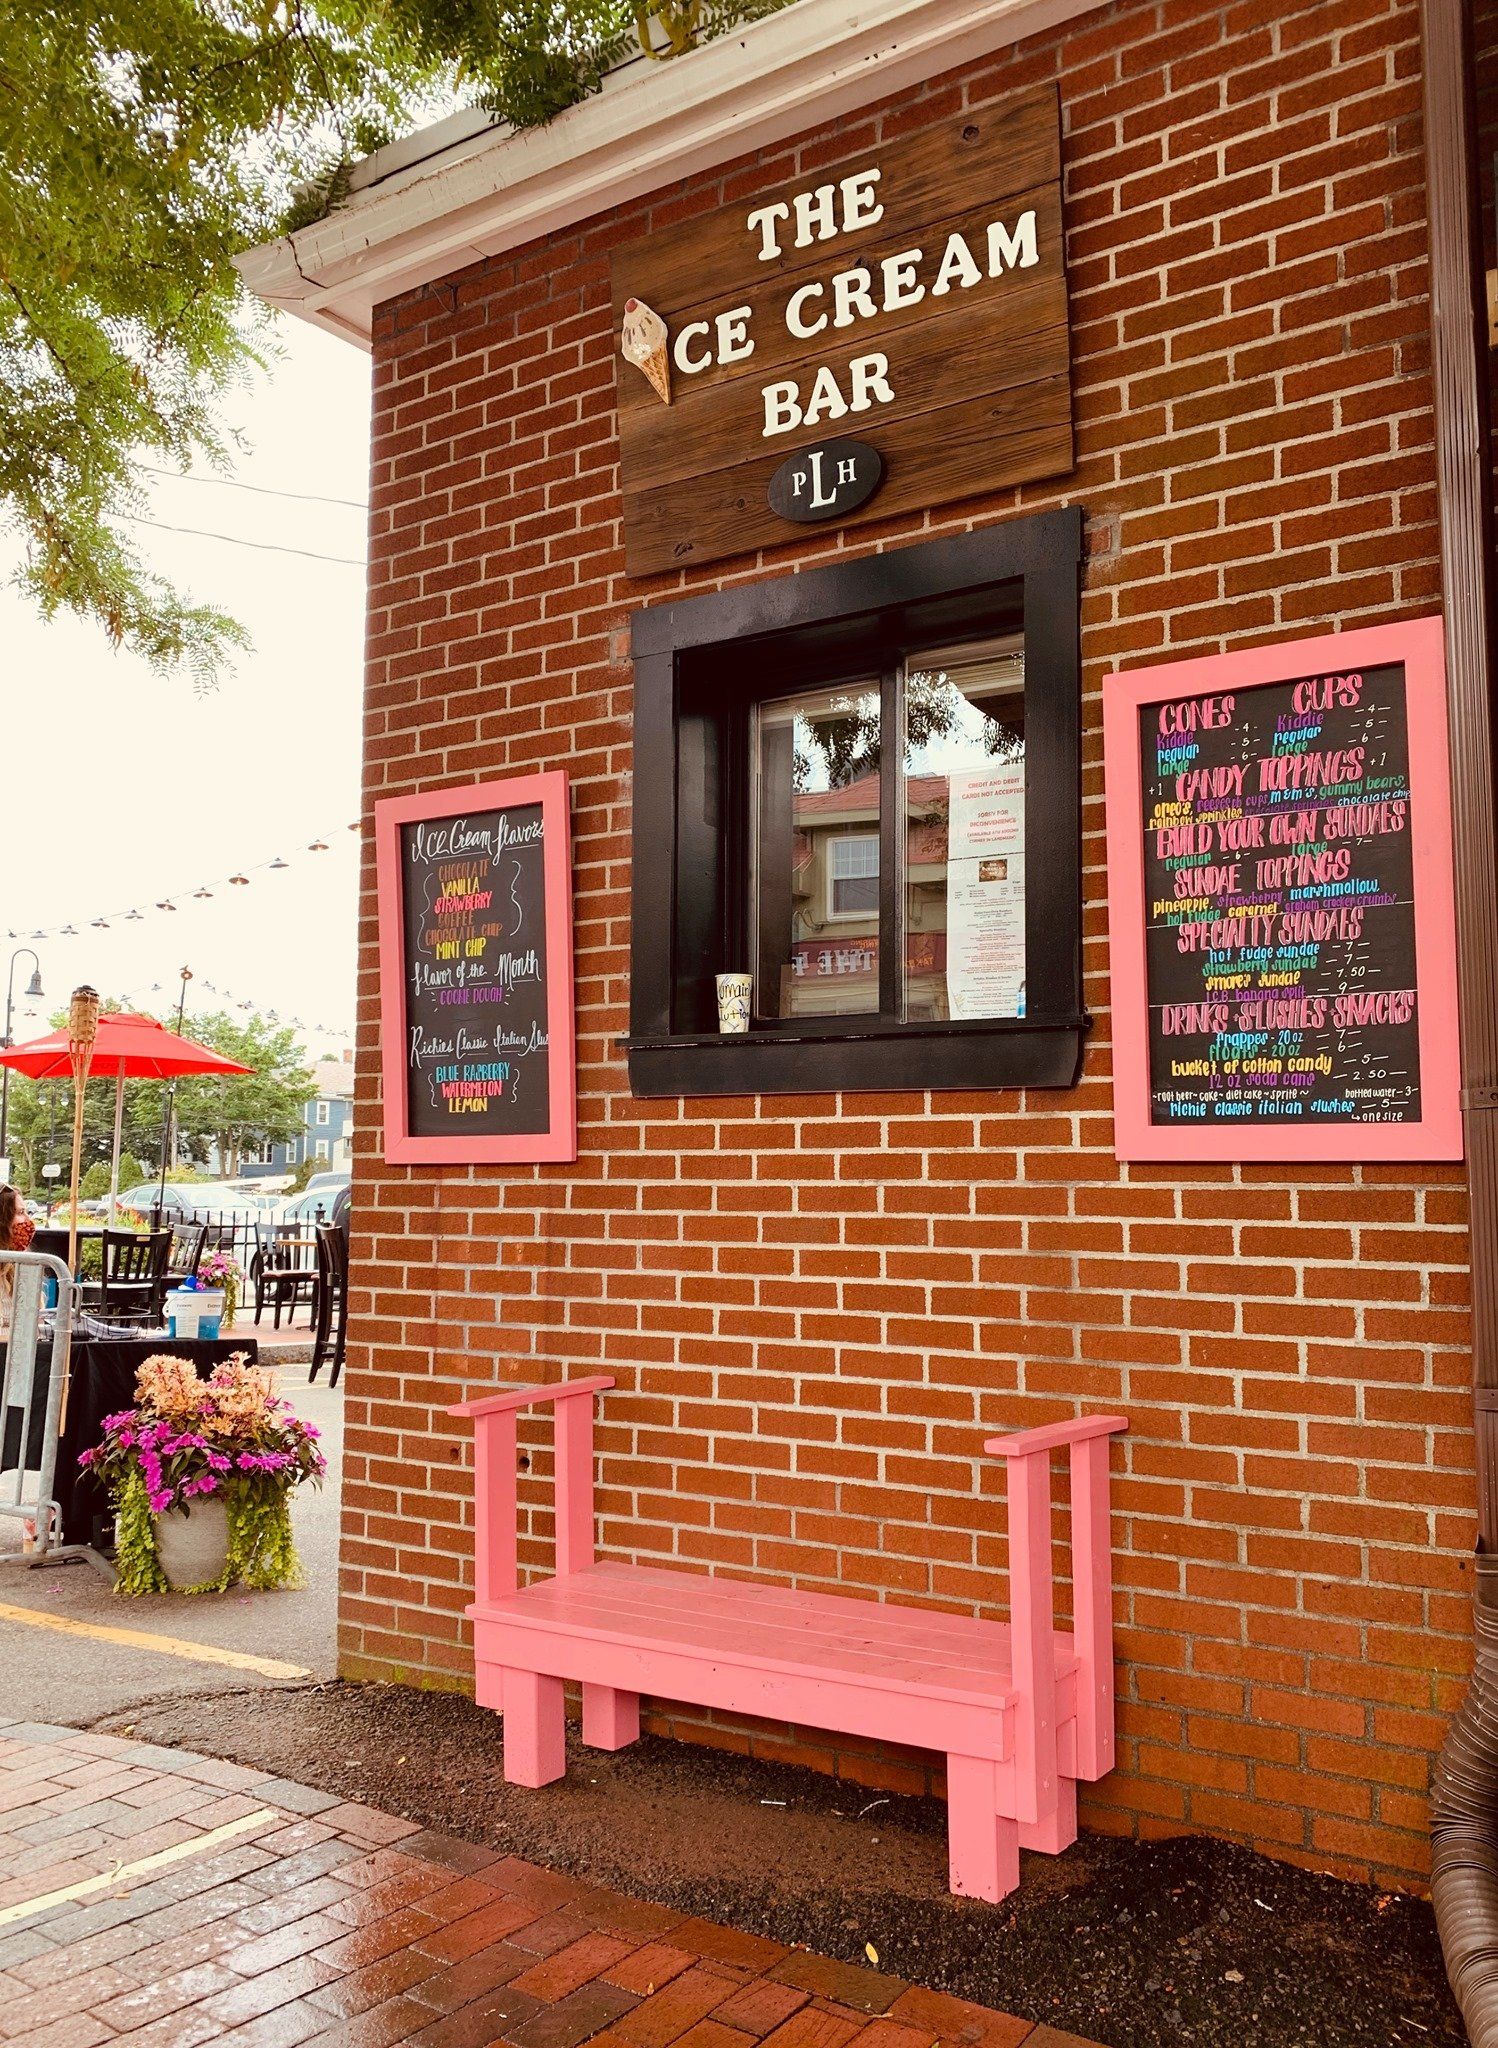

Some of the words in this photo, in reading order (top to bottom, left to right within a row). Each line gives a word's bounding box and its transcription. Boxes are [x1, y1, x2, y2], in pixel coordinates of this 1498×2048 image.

[747, 168, 885, 262] THE
[673, 305, 756, 375] CE
[785, 210, 1041, 339] CREAM
[761, 352, 896, 438] BAR
[1291, 673, 1363, 715] CUPS
[1158, 695, 1236, 736] CONES
[1273, 726, 1323, 747] regular
[1156, 743, 1200, 765] regular
[1271, 740, 1309, 758] large
[1157, 759, 1190, 778] large
[1175, 763, 1252, 802] CANDY
[1257, 746, 1365, 792] TOPPINGS
[1319, 779, 1363, 800] gummy
[1337, 792, 1391, 807] chocolate
[449, 819, 493, 856] Cream
[1156, 824, 1213, 860] BUILD
[1216, 817, 1265, 853] YOUR
[1269, 810, 1318, 845] OWN
[1323, 800, 1406, 840] SUNDAES
[1165, 853, 1212, 872] regular
[1291, 841, 1328, 860] large
[438, 858, 490, 882] CHOCOLATE
[1173, 864, 1242, 900] SUNDAE
[1254, 848, 1351, 891] TOPPINGS
[441, 876, 480, 898] VANILLA
[434, 890, 493, 915] STRAWBERRY
[437, 910, 475, 927] COFFEE
[1166, 912, 1184, 927] hot
[1187, 909, 1221, 924] fudge
[425, 925, 476, 946] CHOCOLATE
[481, 922, 503, 937] CHIP
[1176, 914, 1278, 954] SPECIALTY
[1277, 906, 1364, 946] SUNDAES
[436, 940, 461, 960] MINT
[465, 937, 487, 958] CHIP
[1209, 948, 1232, 963] hot
[1240, 946, 1274, 961] fudge
[1276, 942, 1321, 958] sundae
[456, 960, 467, 988] of
[467, 963, 488, 979] the
[494, 949, 542, 992] Month
[1201, 959, 1269, 977] strawberry
[1271, 955, 1318, 972] sundae
[1258, 970, 1301, 988] sundae
[440, 988, 471, 1006] COOKIE
[473, 986, 503, 1003] DOUGH
[1234, 987, 1279, 1002] banana
[1281, 984, 1306, 1000] split
[1162, 1003, 1230, 1036] DRINKS
[1238, 998, 1328, 1032] SLUSHES
[1333, 991, 1415, 1029] SNACKS
[456, 1027, 489, 1060] Classic
[493, 1024, 528, 1055] Italian
[1216, 1031, 1269, 1050] frappes
[1208, 1044, 1259, 1062] floats
[435, 1064, 460, 1084] BLUE
[1171, 1059, 1217, 1077] bucket
[1223, 1059, 1240, 1074] of
[1242, 1057, 1282, 1074] cotton
[1287, 1053, 1333, 1076] candy
[442, 1080, 503, 1098] WATERMELON
[1208, 1074, 1224, 1090] 12
[1227, 1075, 1242, 1088] oz
[1245, 1072, 1278, 1087] soda
[1282, 1072, 1316, 1087] cans
[448, 1096, 488, 1113] LEMON
[1225, 1089, 1243, 1100] diet
[1243, 1089, 1263, 1100] coke
[1169, 1100, 1207, 1117] richie
[1214, 1101, 1253, 1117] classic
[1258, 1099, 1303, 1115] italian
[1310, 1098, 1356, 1114] slushes
